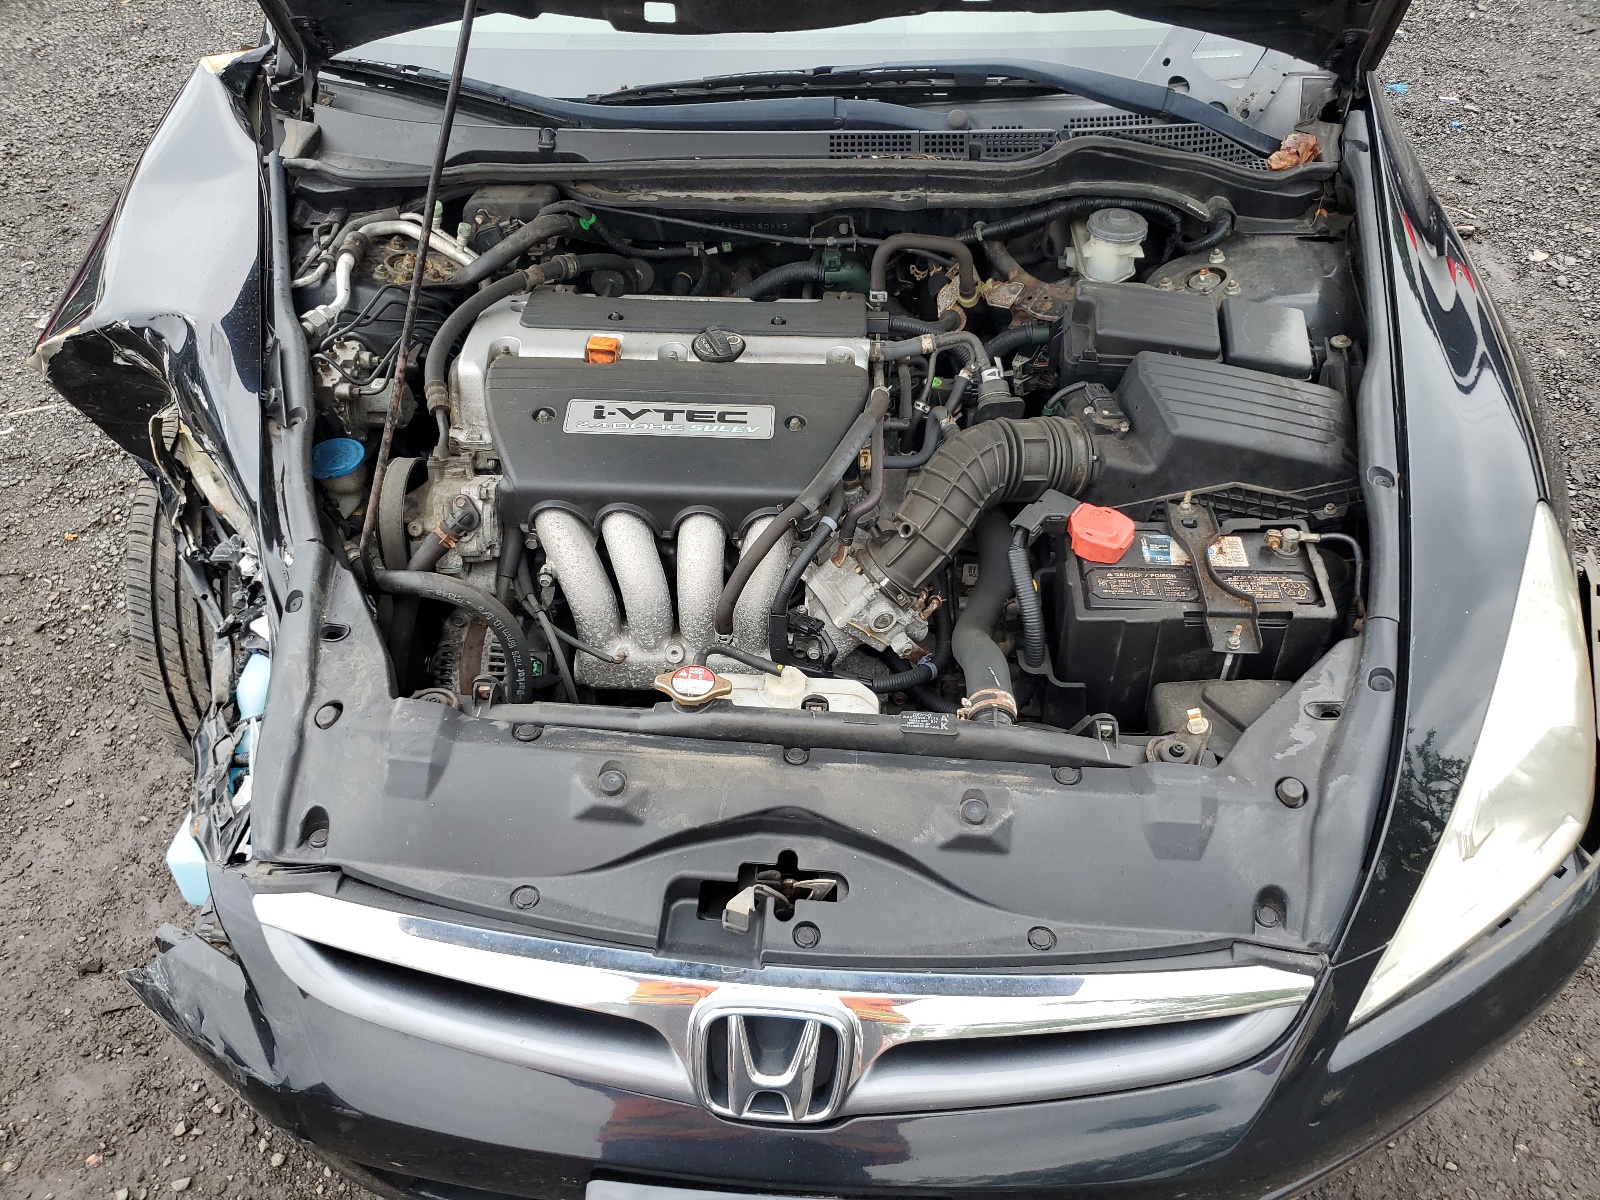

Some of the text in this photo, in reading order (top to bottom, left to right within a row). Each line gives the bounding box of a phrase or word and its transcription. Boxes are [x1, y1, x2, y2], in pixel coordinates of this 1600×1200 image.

[593, 404, 748, 424] i-VTEC
[612, 422, 684, 431] DOHC
[688, 424, 761, 433] SULEV
